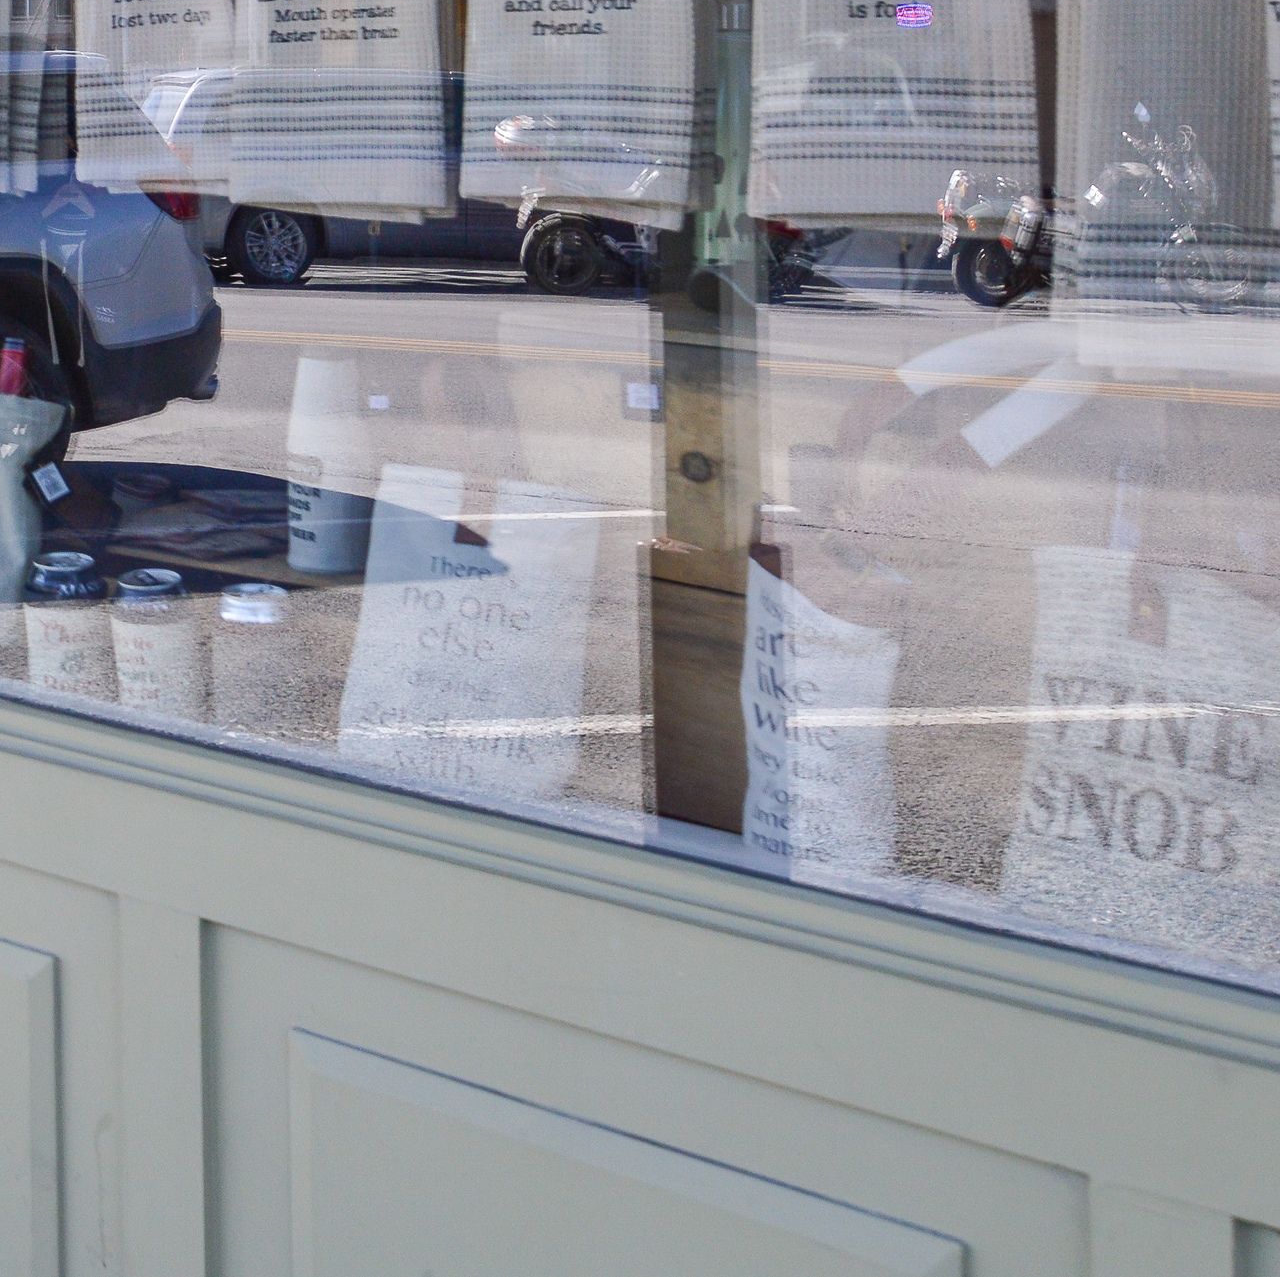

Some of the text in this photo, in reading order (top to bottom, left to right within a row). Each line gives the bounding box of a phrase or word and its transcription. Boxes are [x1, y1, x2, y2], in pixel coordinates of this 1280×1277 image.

[112, 14, 144, 29] lost
[149, 12, 178, 25] two
[275, 6, 396, 22] Mouth operates
[848, 1, 869, 19] is
[269, 28, 358, 43] faster than
[402, 586, 532, 632] no one
[418, 623, 495, 661] else
[754, 626, 816, 658] are
[757, 657, 820, 706] like
[1043, 673, 1267, 786] WINE
[1022, 768, 1240, 875] SNOB
